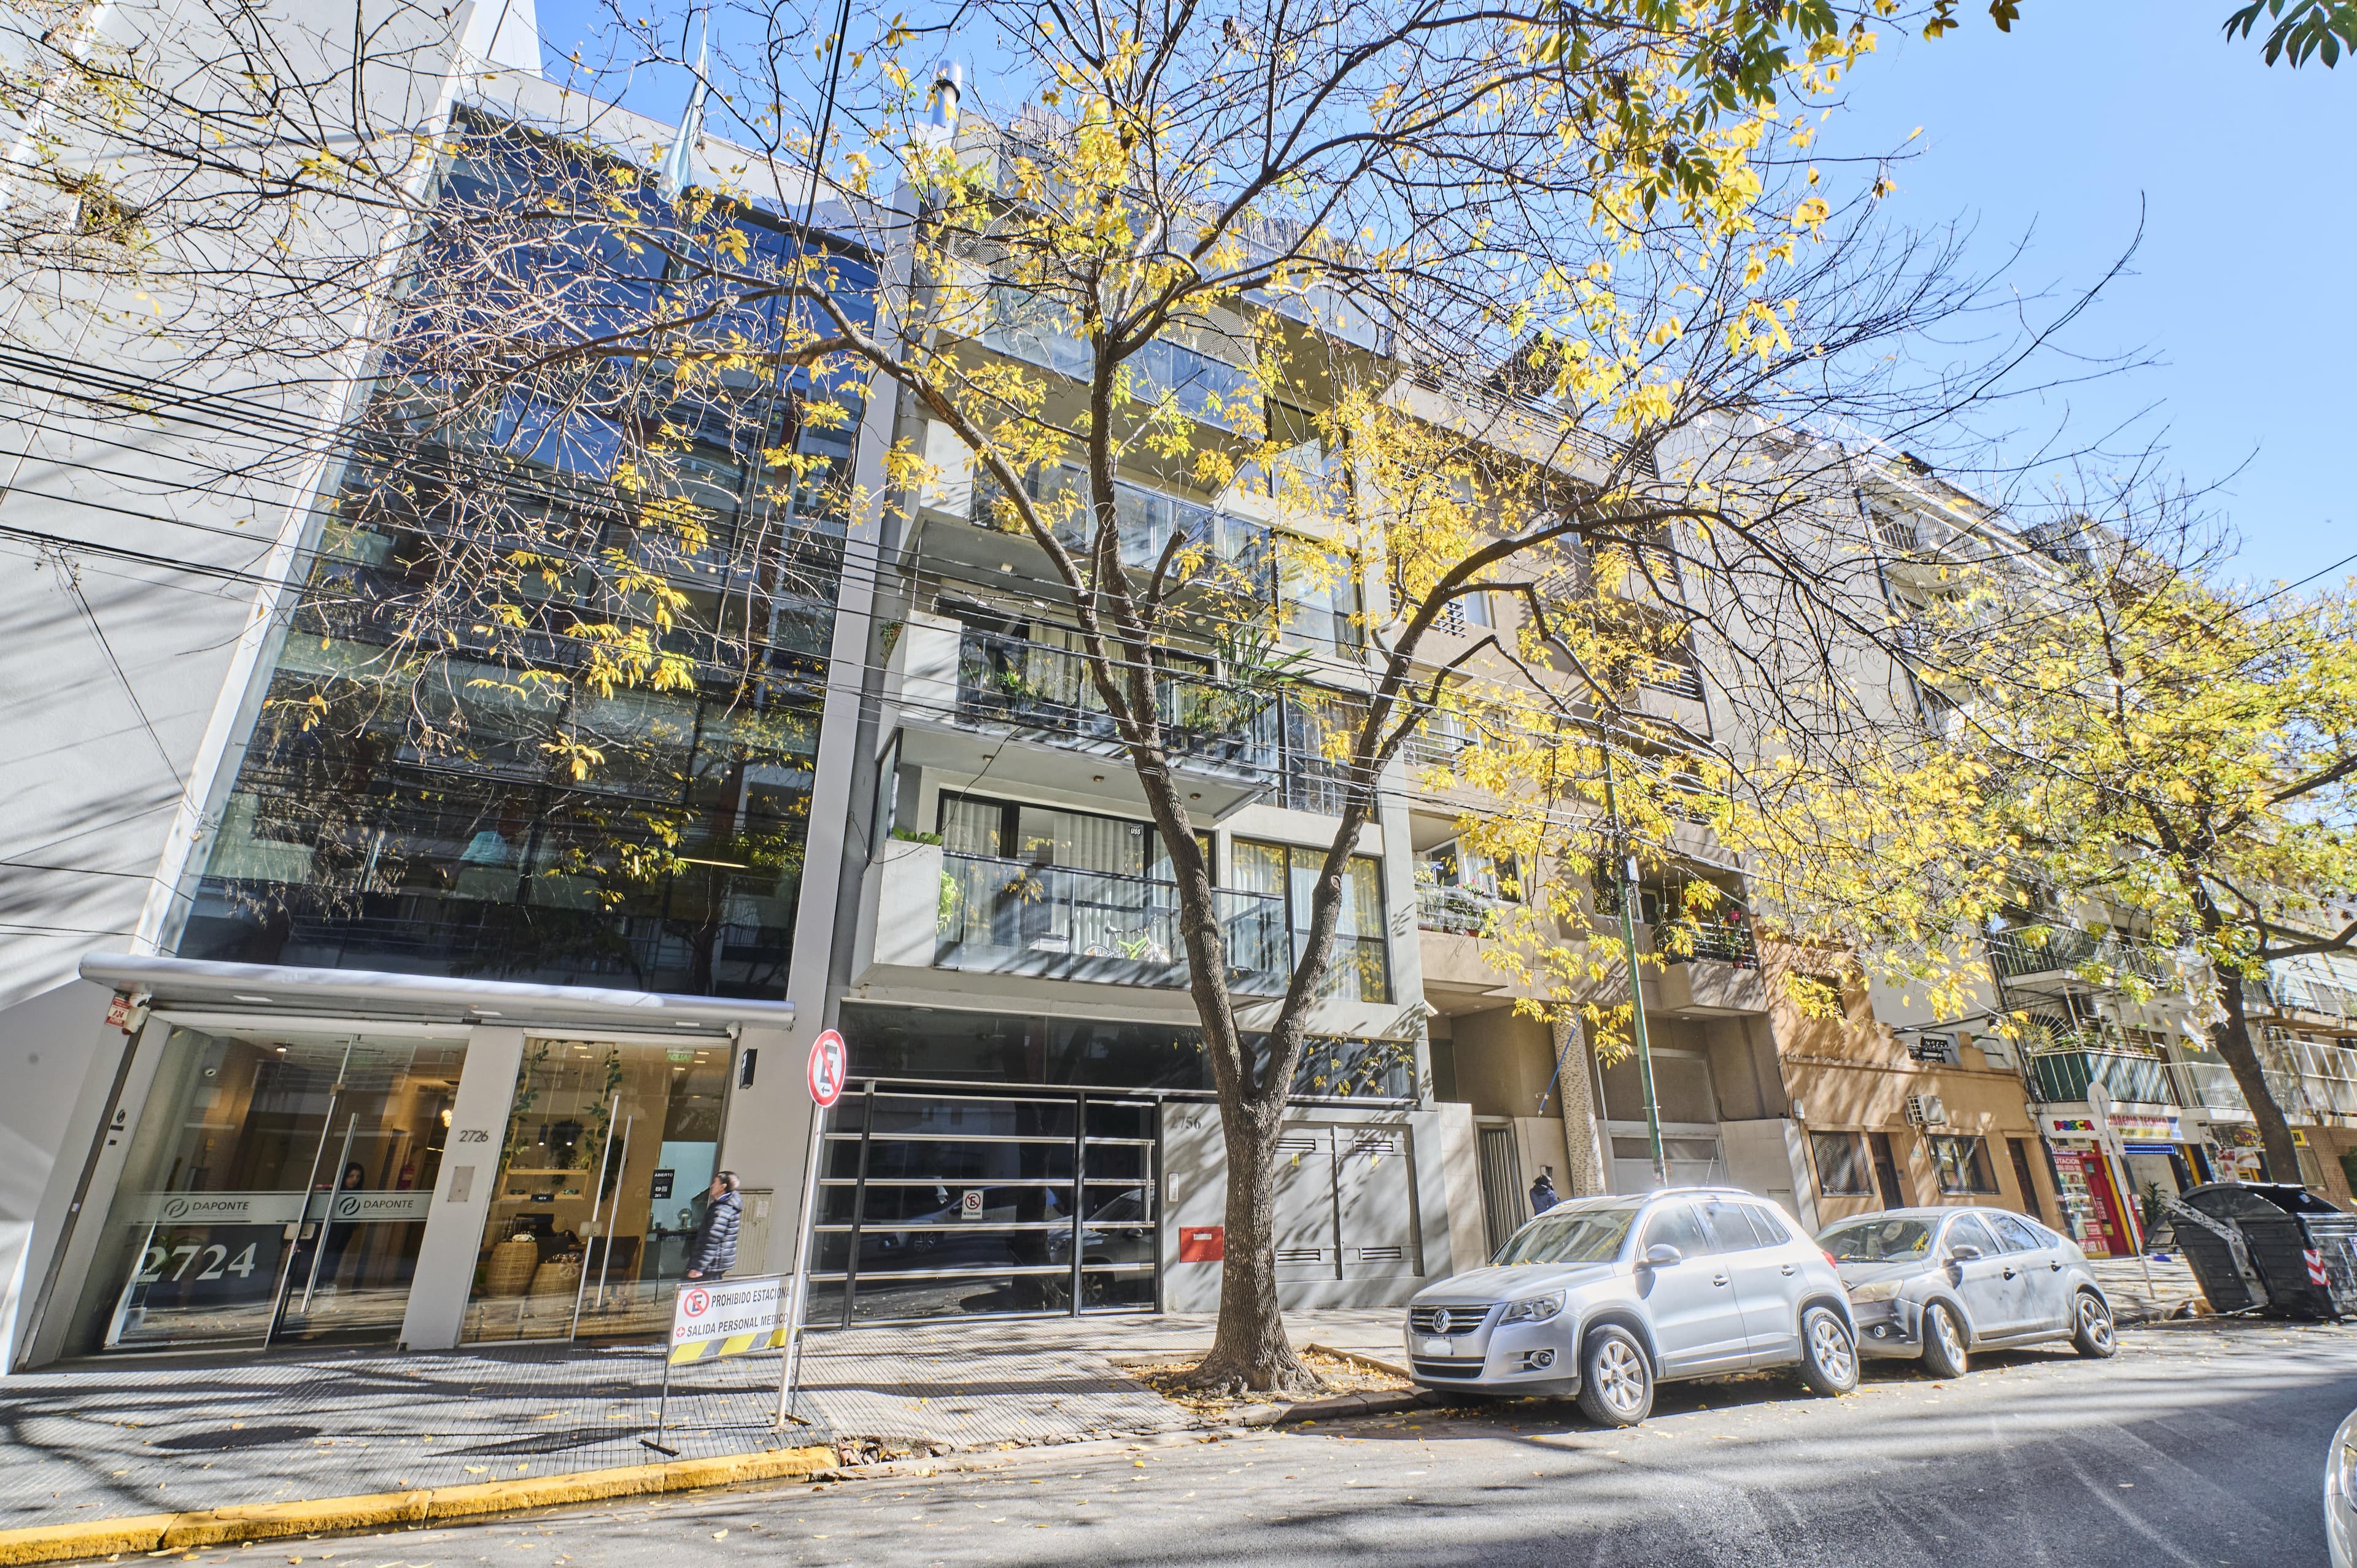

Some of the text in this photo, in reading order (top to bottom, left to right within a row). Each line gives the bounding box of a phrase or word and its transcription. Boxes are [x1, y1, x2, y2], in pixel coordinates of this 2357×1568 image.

[1170, 1116, 1201, 1130] 2756
[2053, 1119, 2096, 1131] POSCA
[459, 1130, 489, 1142] 2726
[192, 1202, 250, 1211] DAPONTE
[363, 1200, 414, 1208] DAPONTE
[136, 1242, 257, 1282] 2724
[711, 1286, 791, 1308] PROHIBIDO ESTACIONA
[687, 1312, 789, 1337] SALIDA PERSONAL MEDICO
